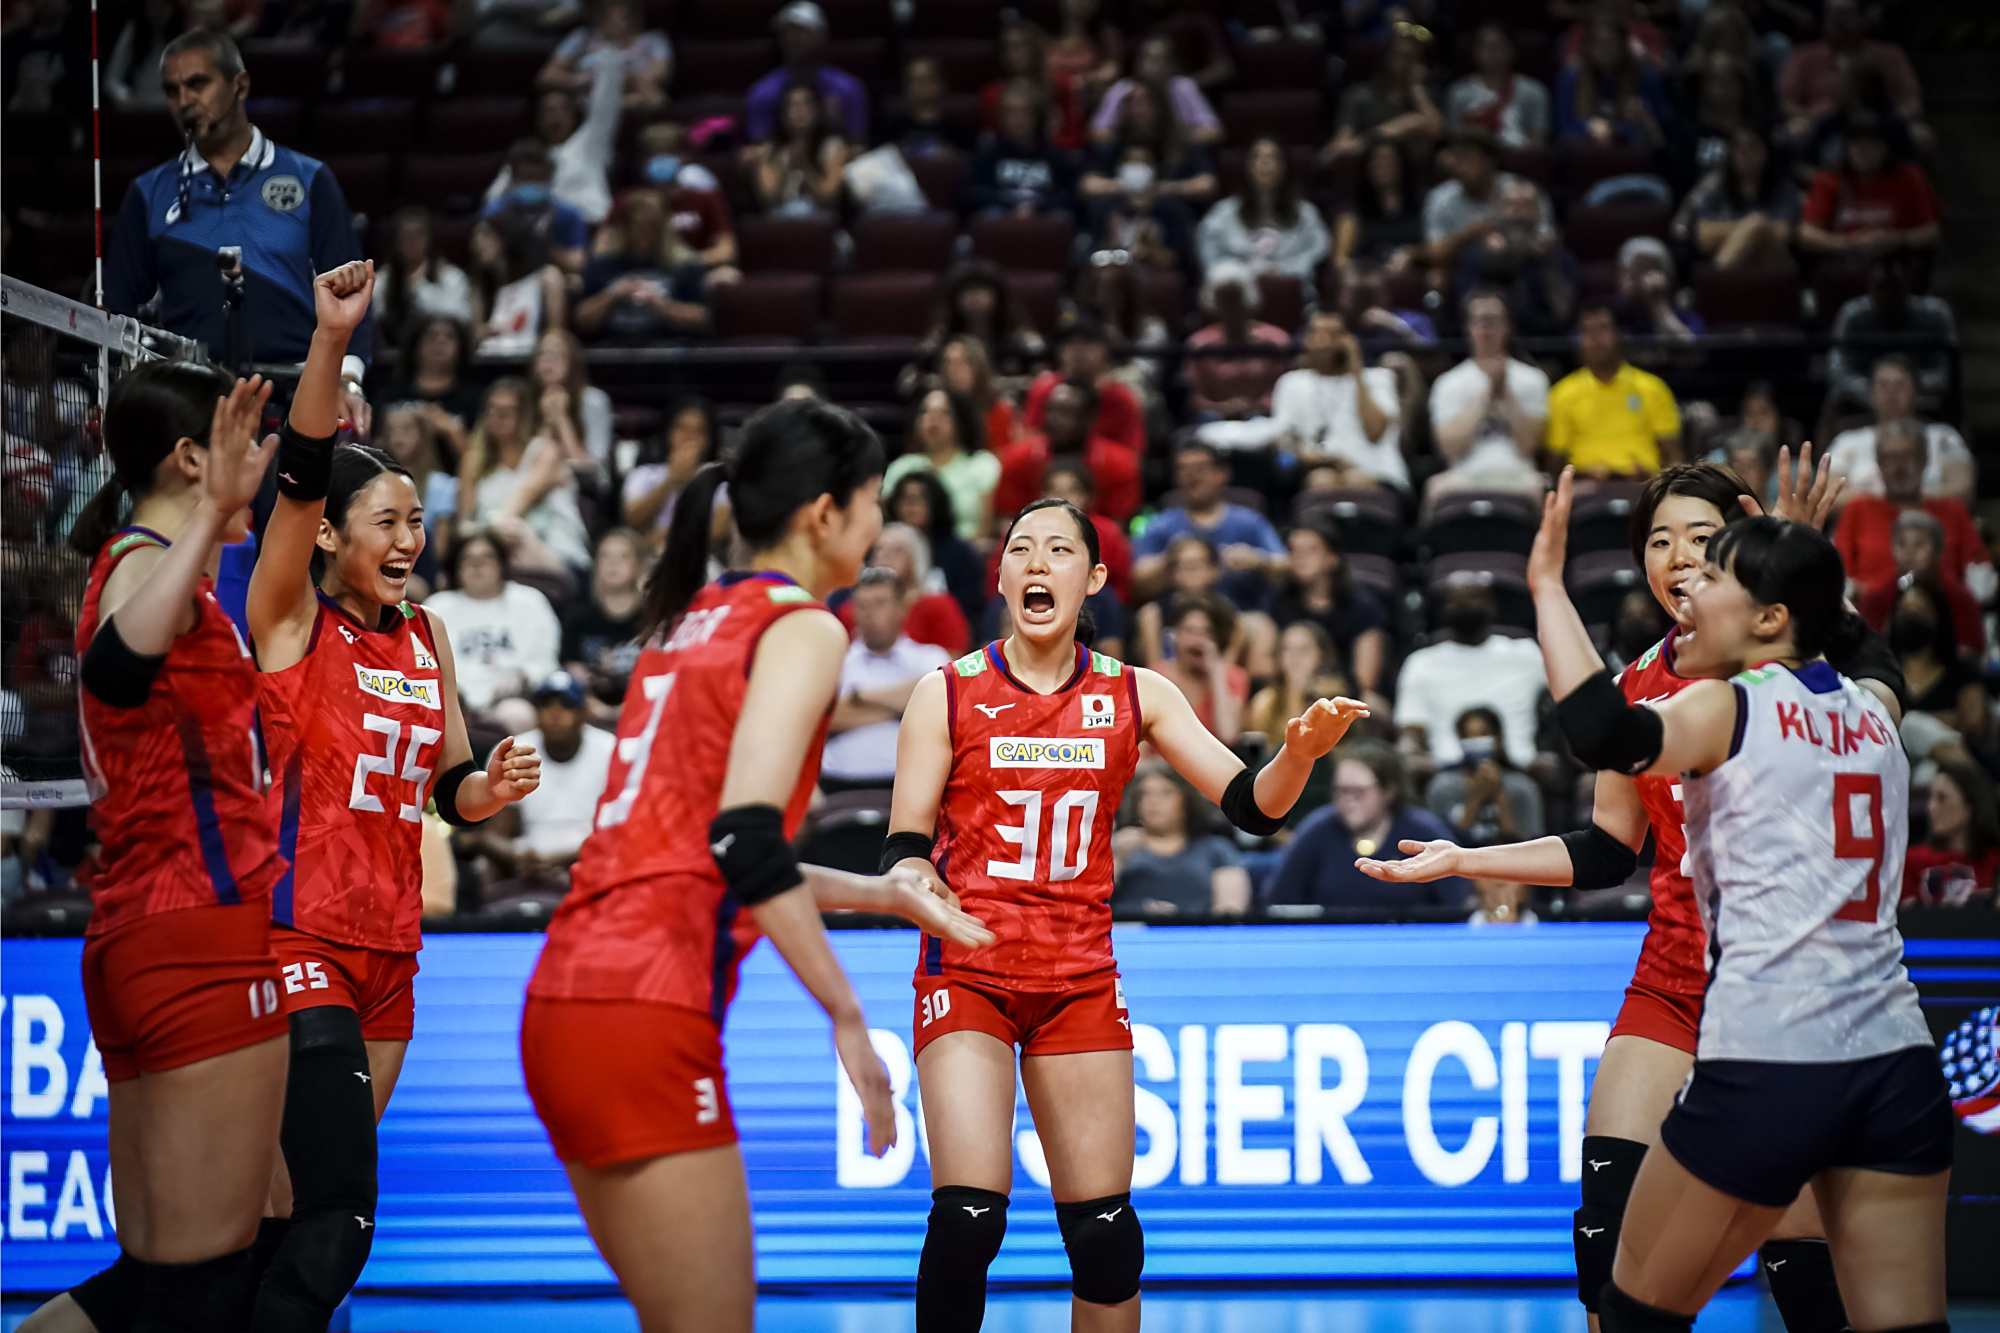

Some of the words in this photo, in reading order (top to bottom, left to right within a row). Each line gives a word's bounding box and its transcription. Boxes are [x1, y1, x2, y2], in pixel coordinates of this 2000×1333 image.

[359, 671, 431, 703] CAPCM
[1088, 716, 1111, 727] JPN
[349, 713, 442, 823] 25
[596, 672, 677, 829] 3
[996, 743, 1095, 763] CAPCOM
[986, 790, 1100, 882] 30
[1832, 772, 1886, 924] 9
[248, 979, 278, 1019] 10
[282, 961, 329, 995] 25
[922, 988, 951, 1029] 30
[693, 1077, 720, 1124] 3
[0, 1150, 116, 1241] EA
